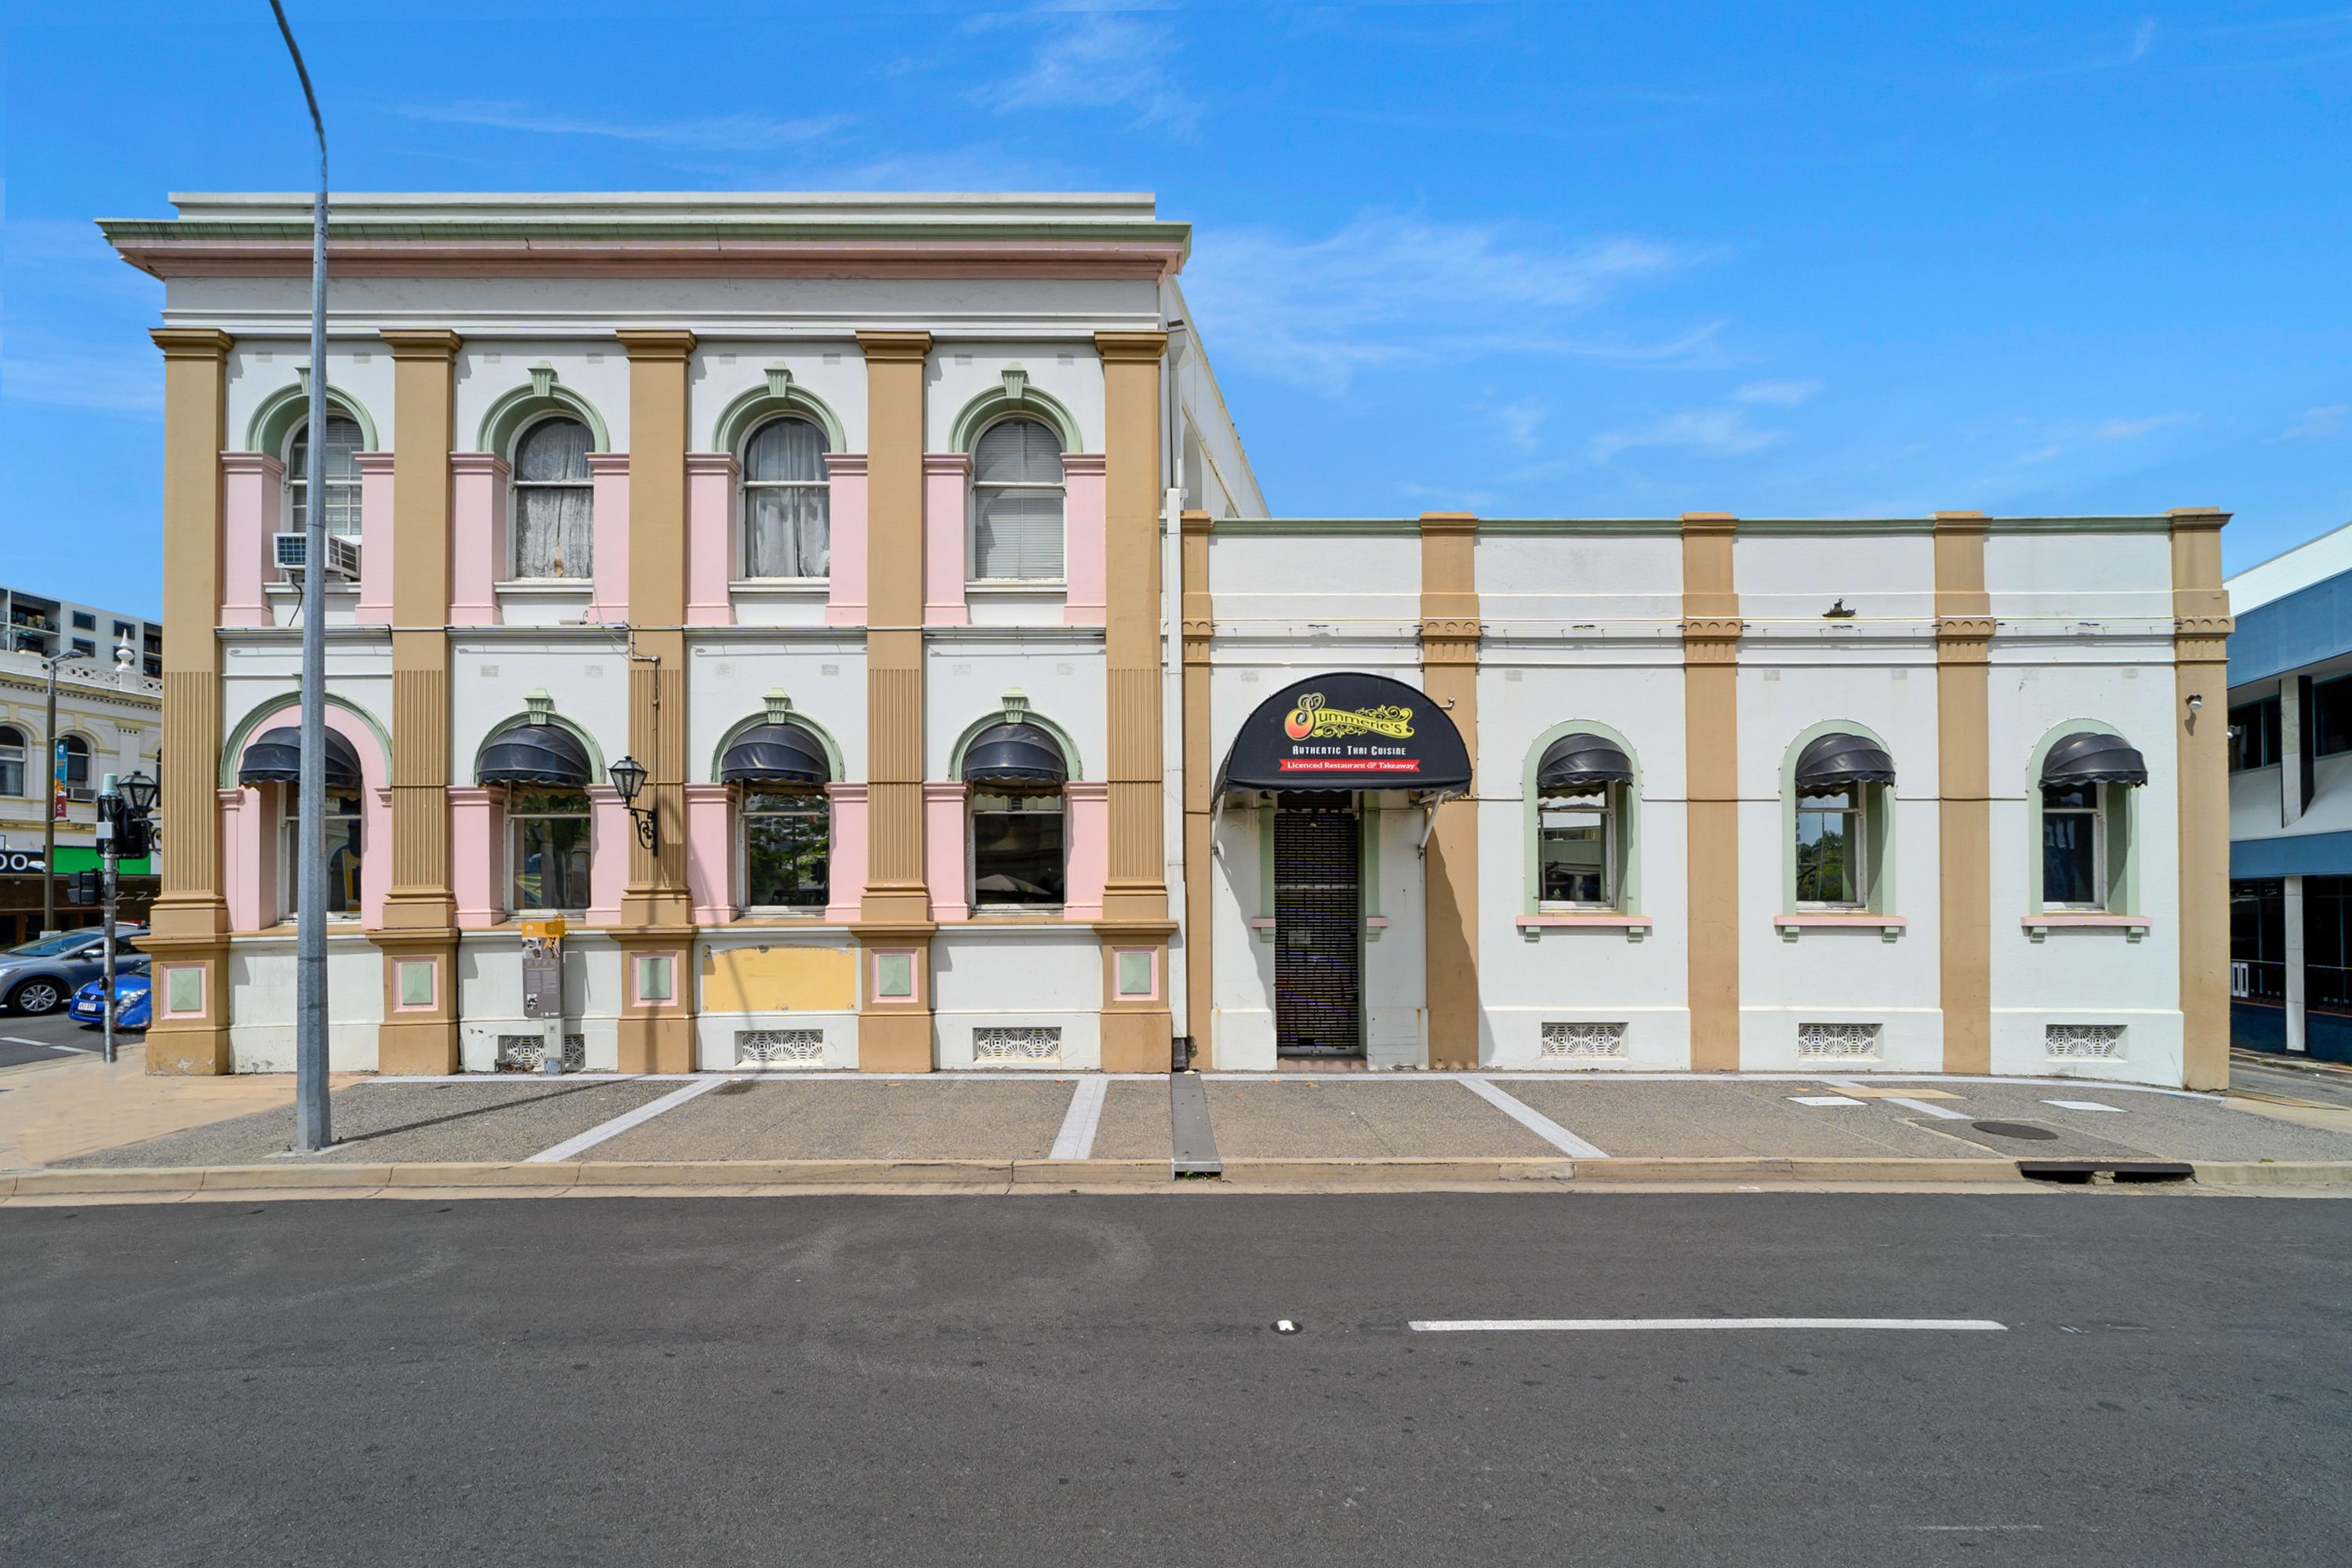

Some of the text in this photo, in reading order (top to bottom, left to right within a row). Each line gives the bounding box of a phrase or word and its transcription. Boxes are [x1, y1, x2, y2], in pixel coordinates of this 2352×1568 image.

[1285, 692, 1403, 741] Summerie's
[1293, 745, 1406, 756] AUTHENTIC THAI CUISINE
[1378, 762, 1415, 771] Takeaway
